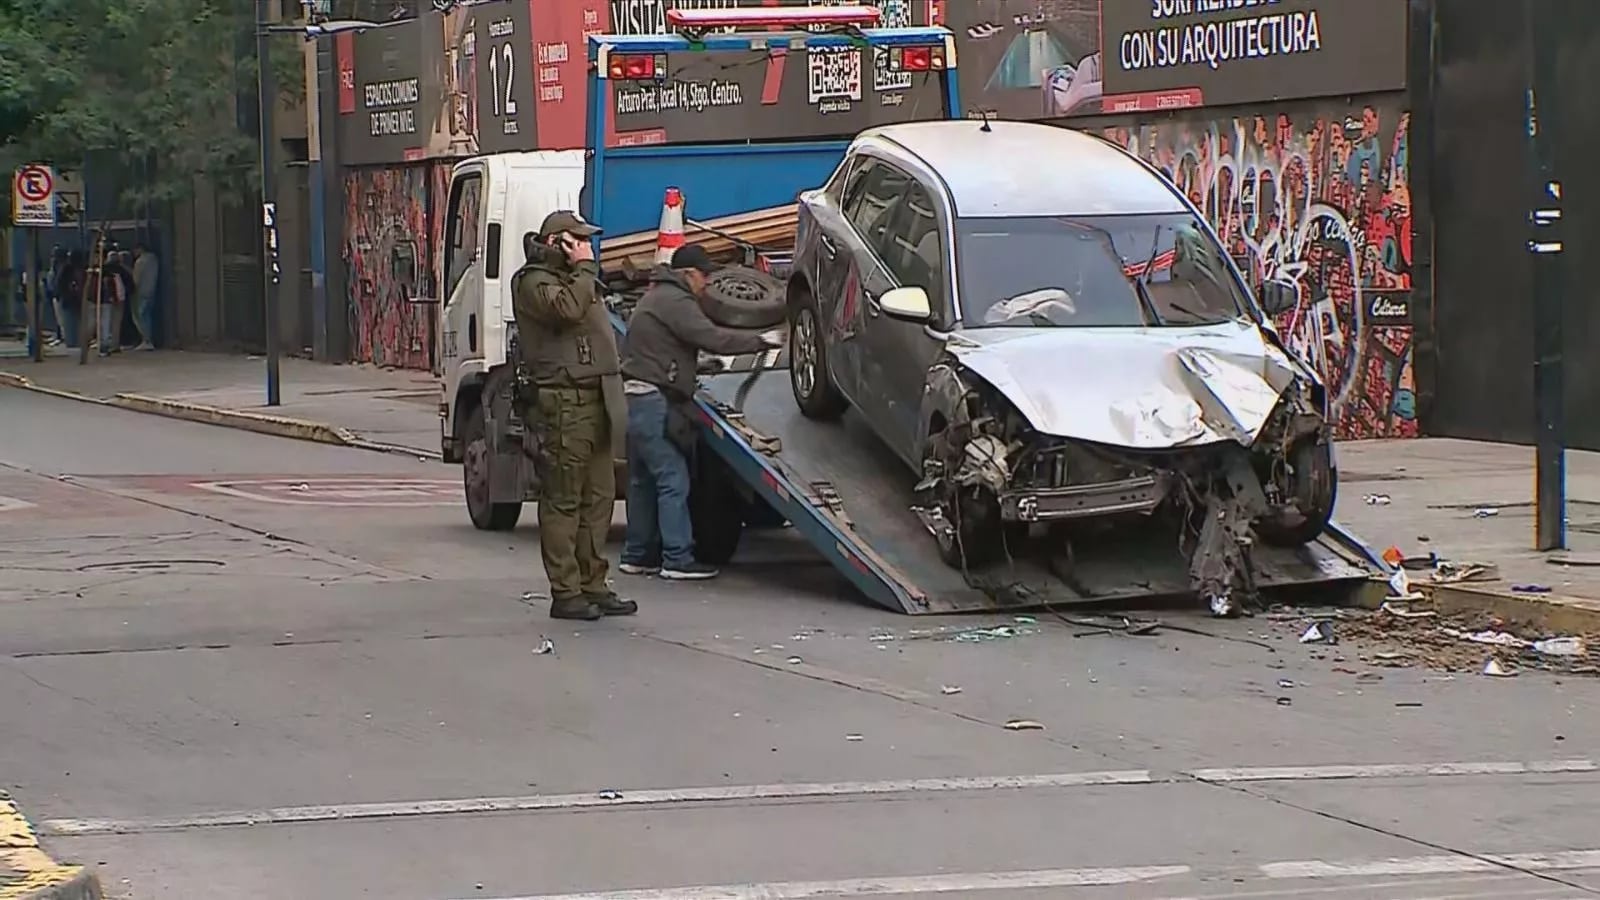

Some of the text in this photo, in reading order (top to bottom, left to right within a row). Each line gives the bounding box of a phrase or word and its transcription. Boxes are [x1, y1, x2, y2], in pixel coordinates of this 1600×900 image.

[1121, 11, 1320, 70] CON SU ARQUITECTURA
[365, 78, 418, 107] ESPACIOS COMUNES
[489, 42, 516, 115] 12
[617, 89, 640, 113] Arturo
[660, 81, 677, 109] local
[711, 80, 742, 105] Centro.
[370, 108, 416, 135] DE PRIMER NIVEL
